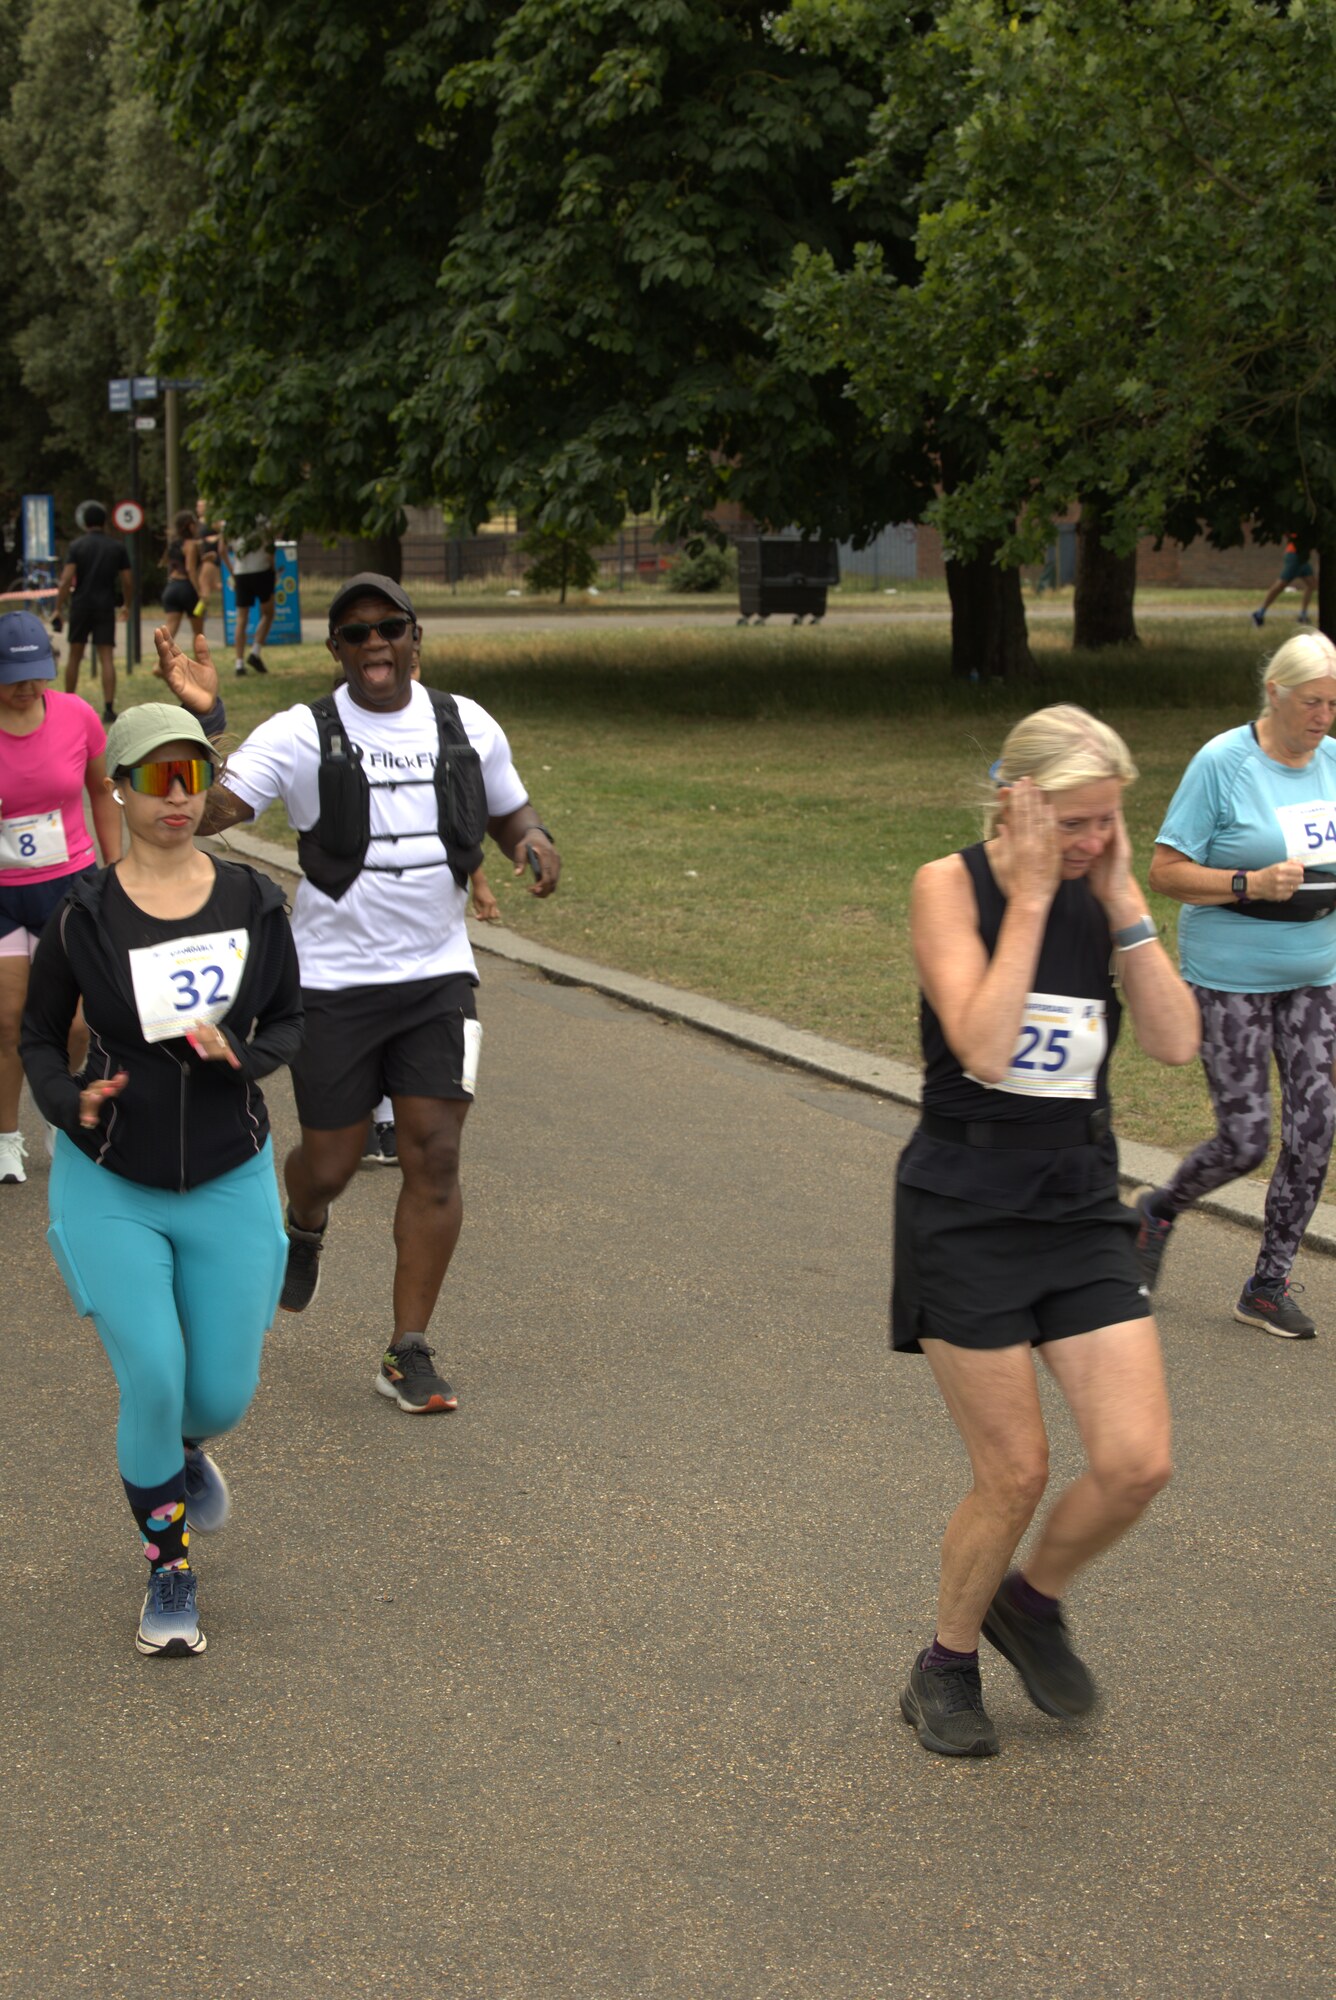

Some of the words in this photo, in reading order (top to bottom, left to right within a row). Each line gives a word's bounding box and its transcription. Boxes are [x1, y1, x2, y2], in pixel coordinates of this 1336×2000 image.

[124, 510, 133, 523] 5
[19, 833, 36, 857] 8
[1304, 821, 1336, 849] 54
[170, 965, 229, 1011] 32
[1010, 1026, 1070, 1072] 25
